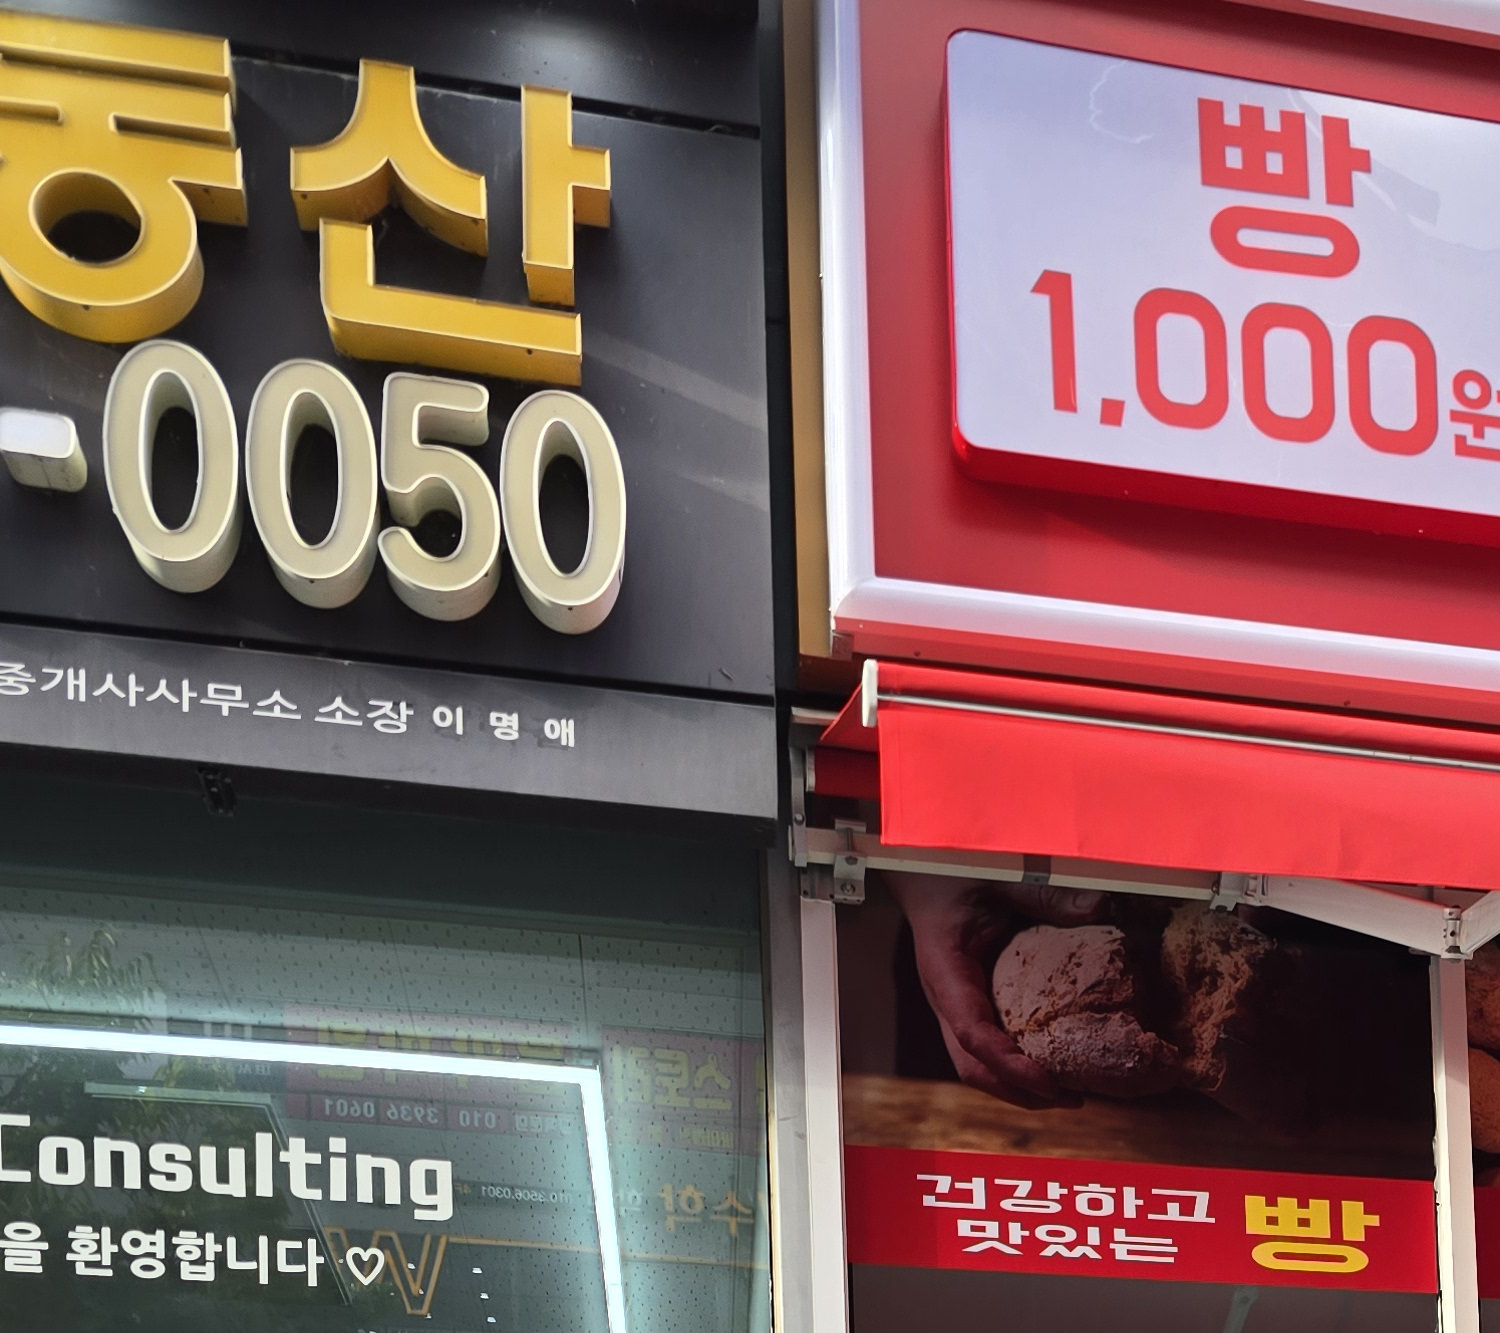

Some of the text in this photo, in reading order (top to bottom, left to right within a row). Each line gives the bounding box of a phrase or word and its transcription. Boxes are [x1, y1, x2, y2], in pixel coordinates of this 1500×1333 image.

[0, 8, 612, 387] 동산
[1197, 97, 1371, 279] 빵
[314, 695, 415, 735] 소장
[0, 1113, 455, 1222] Consulting
[916, 1173, 1216, 1224] 건강하고
[66, 1223, 325, 1287] 환영합니다
[956, 1217, 1179, 1264] 맛있는
[1245, 1194, 1380, 1274] 빵
